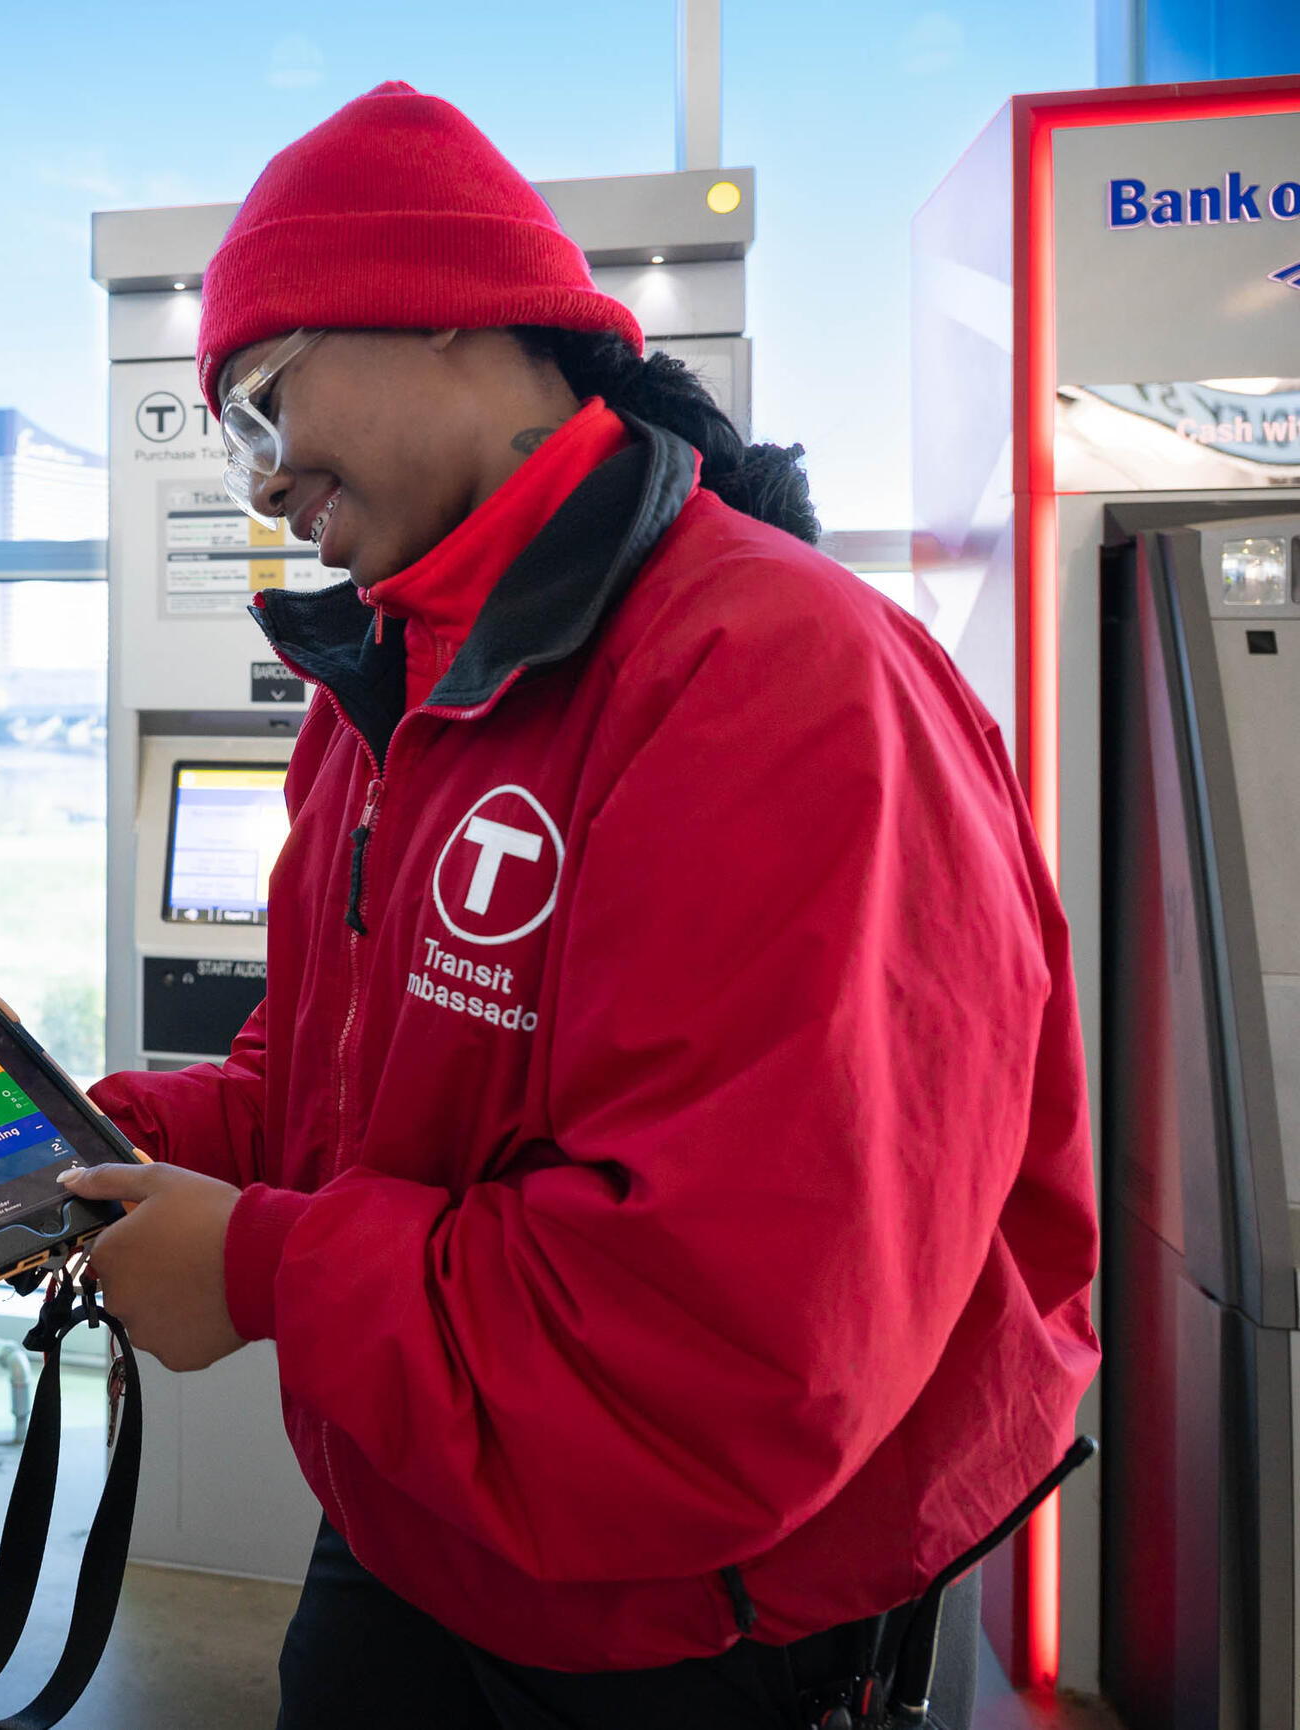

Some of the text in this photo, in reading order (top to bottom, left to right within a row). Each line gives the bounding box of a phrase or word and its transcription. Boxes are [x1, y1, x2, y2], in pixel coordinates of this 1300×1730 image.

[1108, 170, 1300, 231] Bank o
[1176, 414, 1253, 444] Cash
[134, 448, 196, 462] Purchase
[463, 815, 543, 916] T
[197, 961, 233, 977] START
[424, 937, 514, 995] Transit
